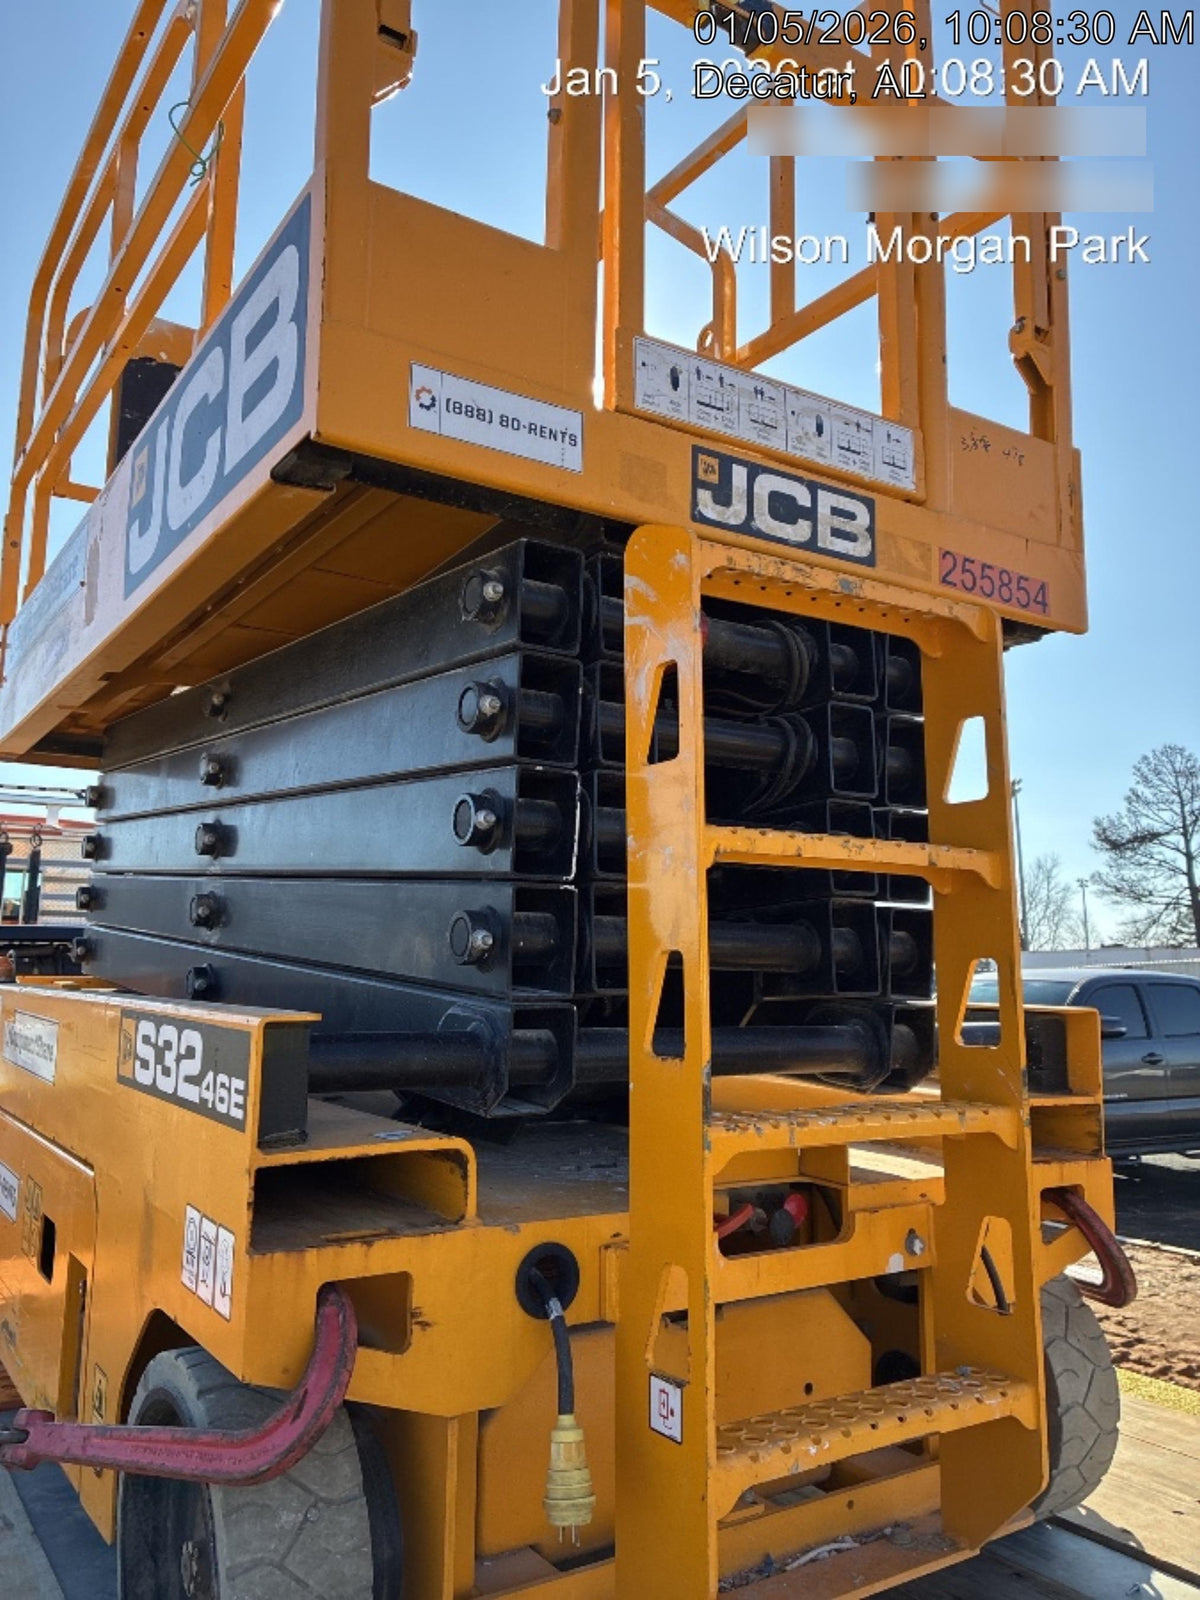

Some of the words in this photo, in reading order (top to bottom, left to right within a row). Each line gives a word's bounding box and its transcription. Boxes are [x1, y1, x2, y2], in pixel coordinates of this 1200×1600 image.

[130, 243, 300, 575] JCB
[445, 397, 493, 425] (888)
[499, 414, 578, 447] 80-RENTS
[695, 462, 873, 558] JCB
[941, 550, 1048, 613] 255854
